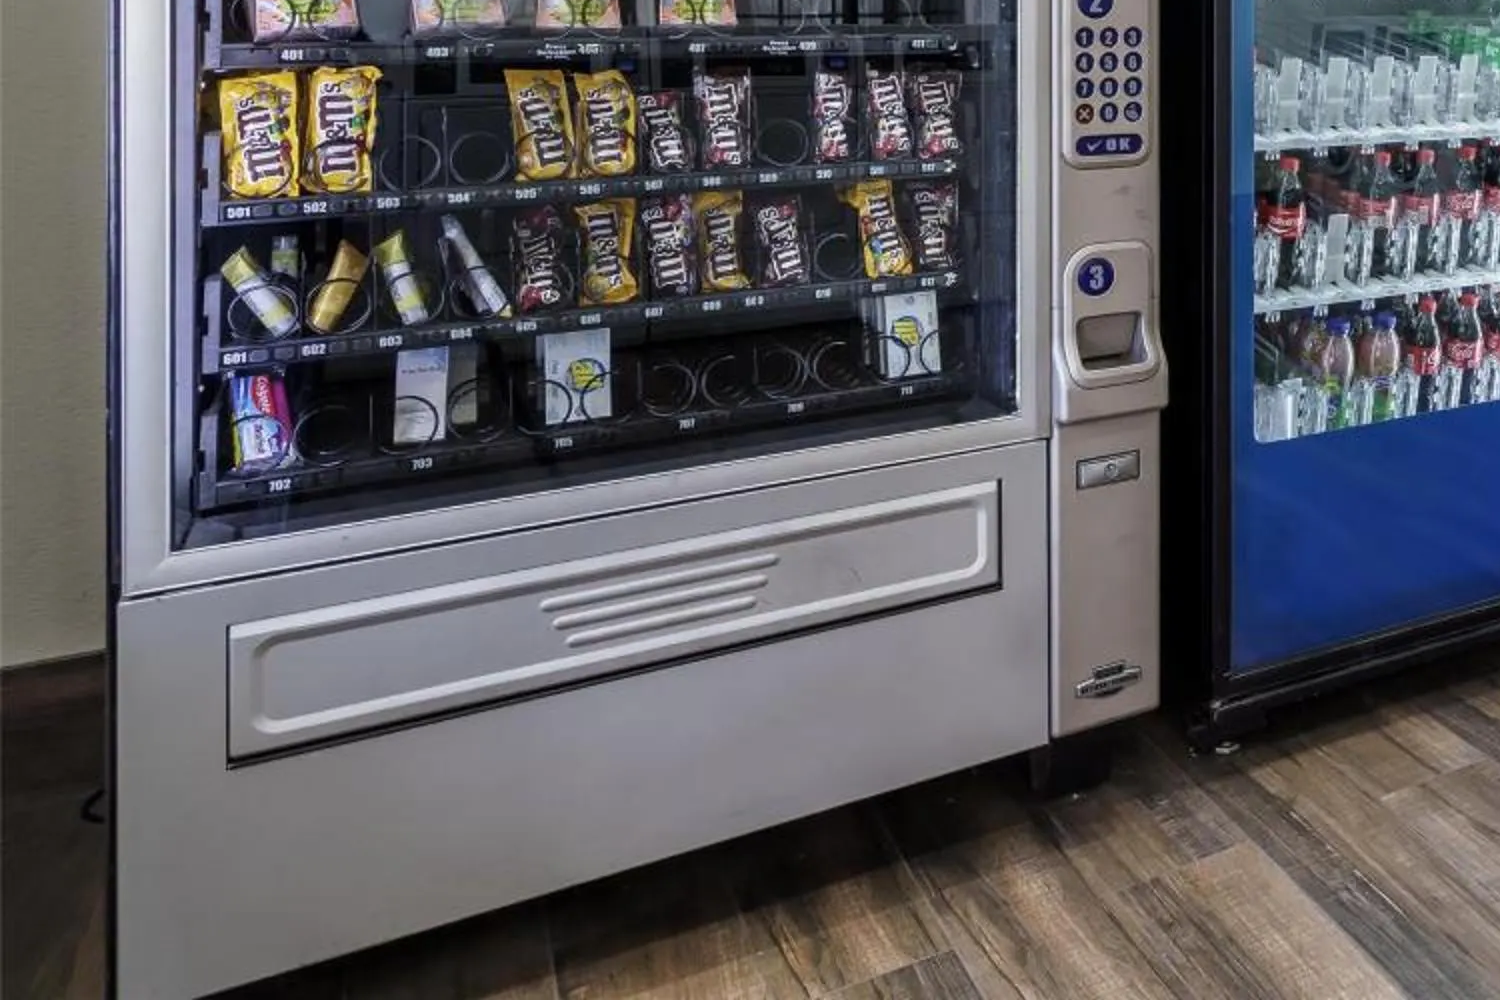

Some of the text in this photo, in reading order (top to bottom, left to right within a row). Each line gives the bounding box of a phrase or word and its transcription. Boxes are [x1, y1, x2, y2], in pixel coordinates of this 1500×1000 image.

[1105, 31, 1113, 45] 2
[1129, 31, 1137, 44] 3
[280, 50, 303, 61] 401
[1129, 55, 1137, 68] 6
[1080, 56, 1089, 69] 4
[1105, 56, 1113, 69] 5
[1081, 81, 1089, 95] 7
[1105, 81, 1113, 94] 8
[1129, 81, 1137, 94] 9
[1105, 105, 1113, 120] 0
[1106, 138, 1131, 151] OK
[227, 207, 251, 218] 501
[303, 202, 327, 213] 502
[1089, 265, 1104, 290] 3
[302, 344, 326, 355] 602
[222, 353, 247, 365] 601
[411, 458, 433, 470] 703
[268, 480, 291, 491] 702
